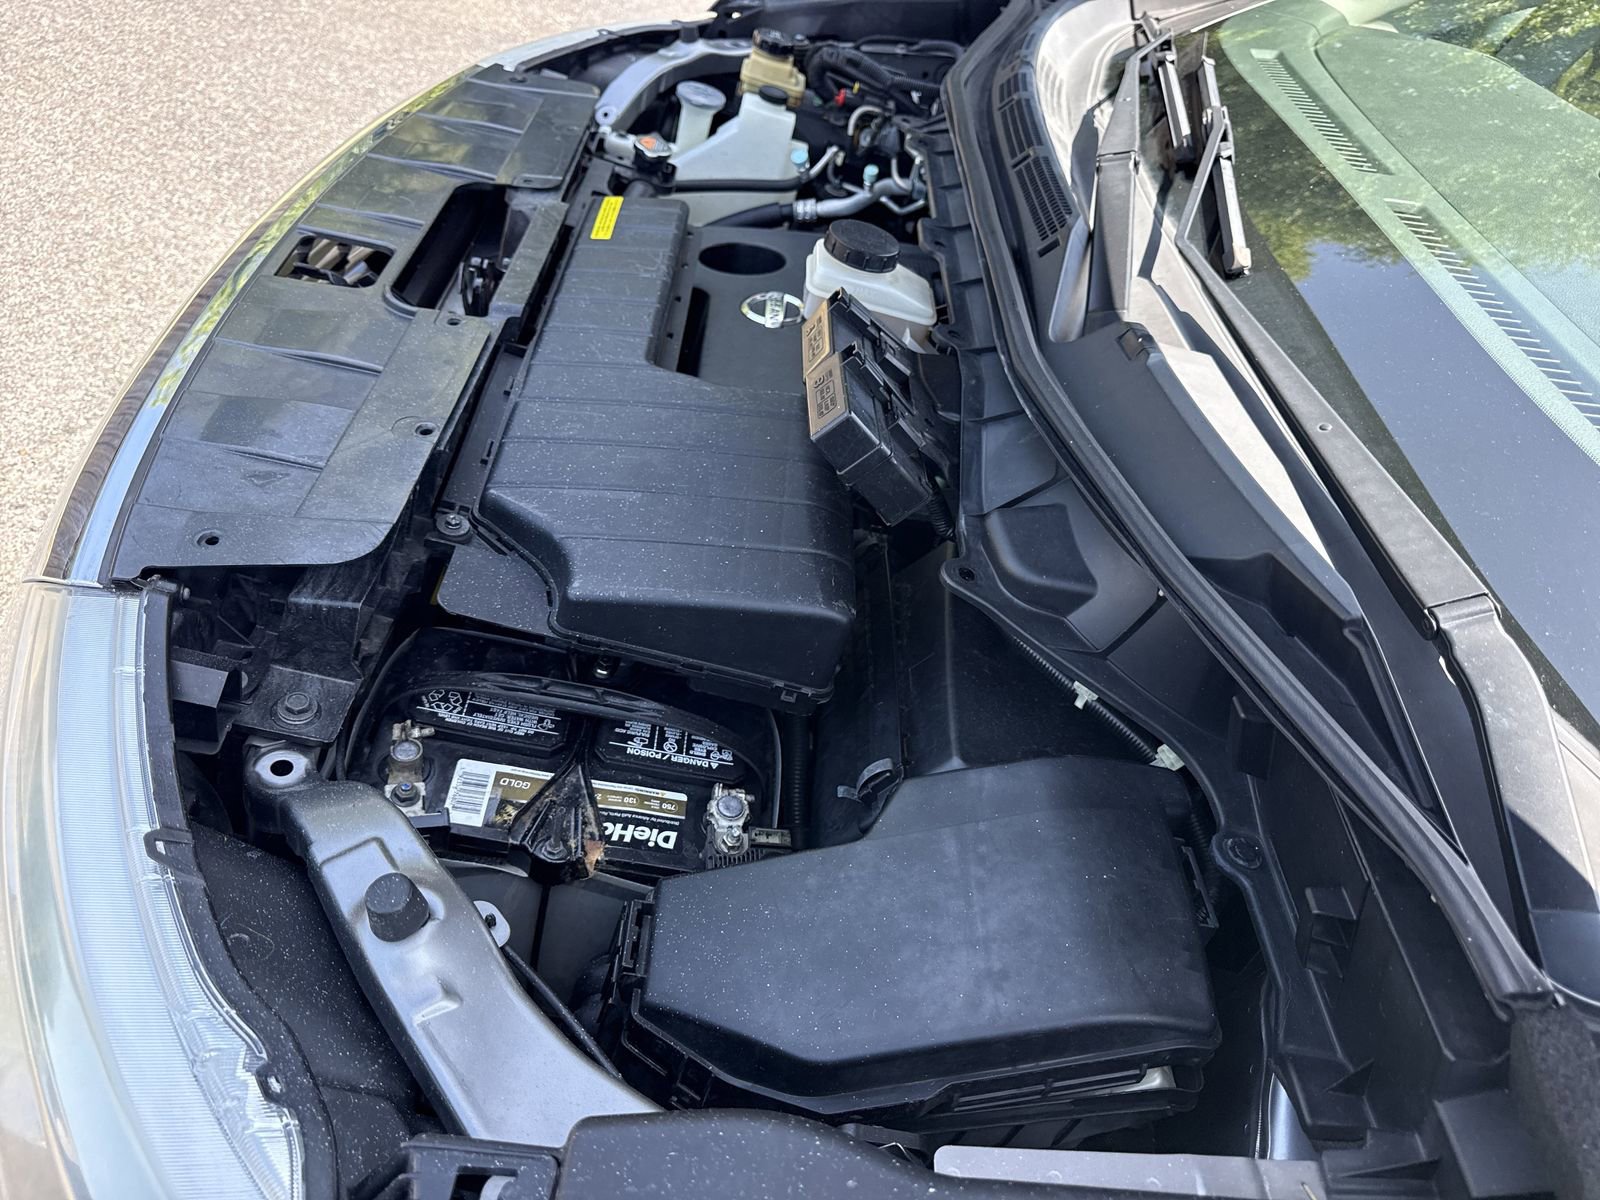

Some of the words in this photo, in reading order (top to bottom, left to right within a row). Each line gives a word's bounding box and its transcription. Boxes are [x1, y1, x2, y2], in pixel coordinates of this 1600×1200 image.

[627, 747, 661, 759] POISON
[671, 755, 708, 767] DANGER
[499, 777, 531, 790] GOLD
[602, 822, 677, 849] DieHa
